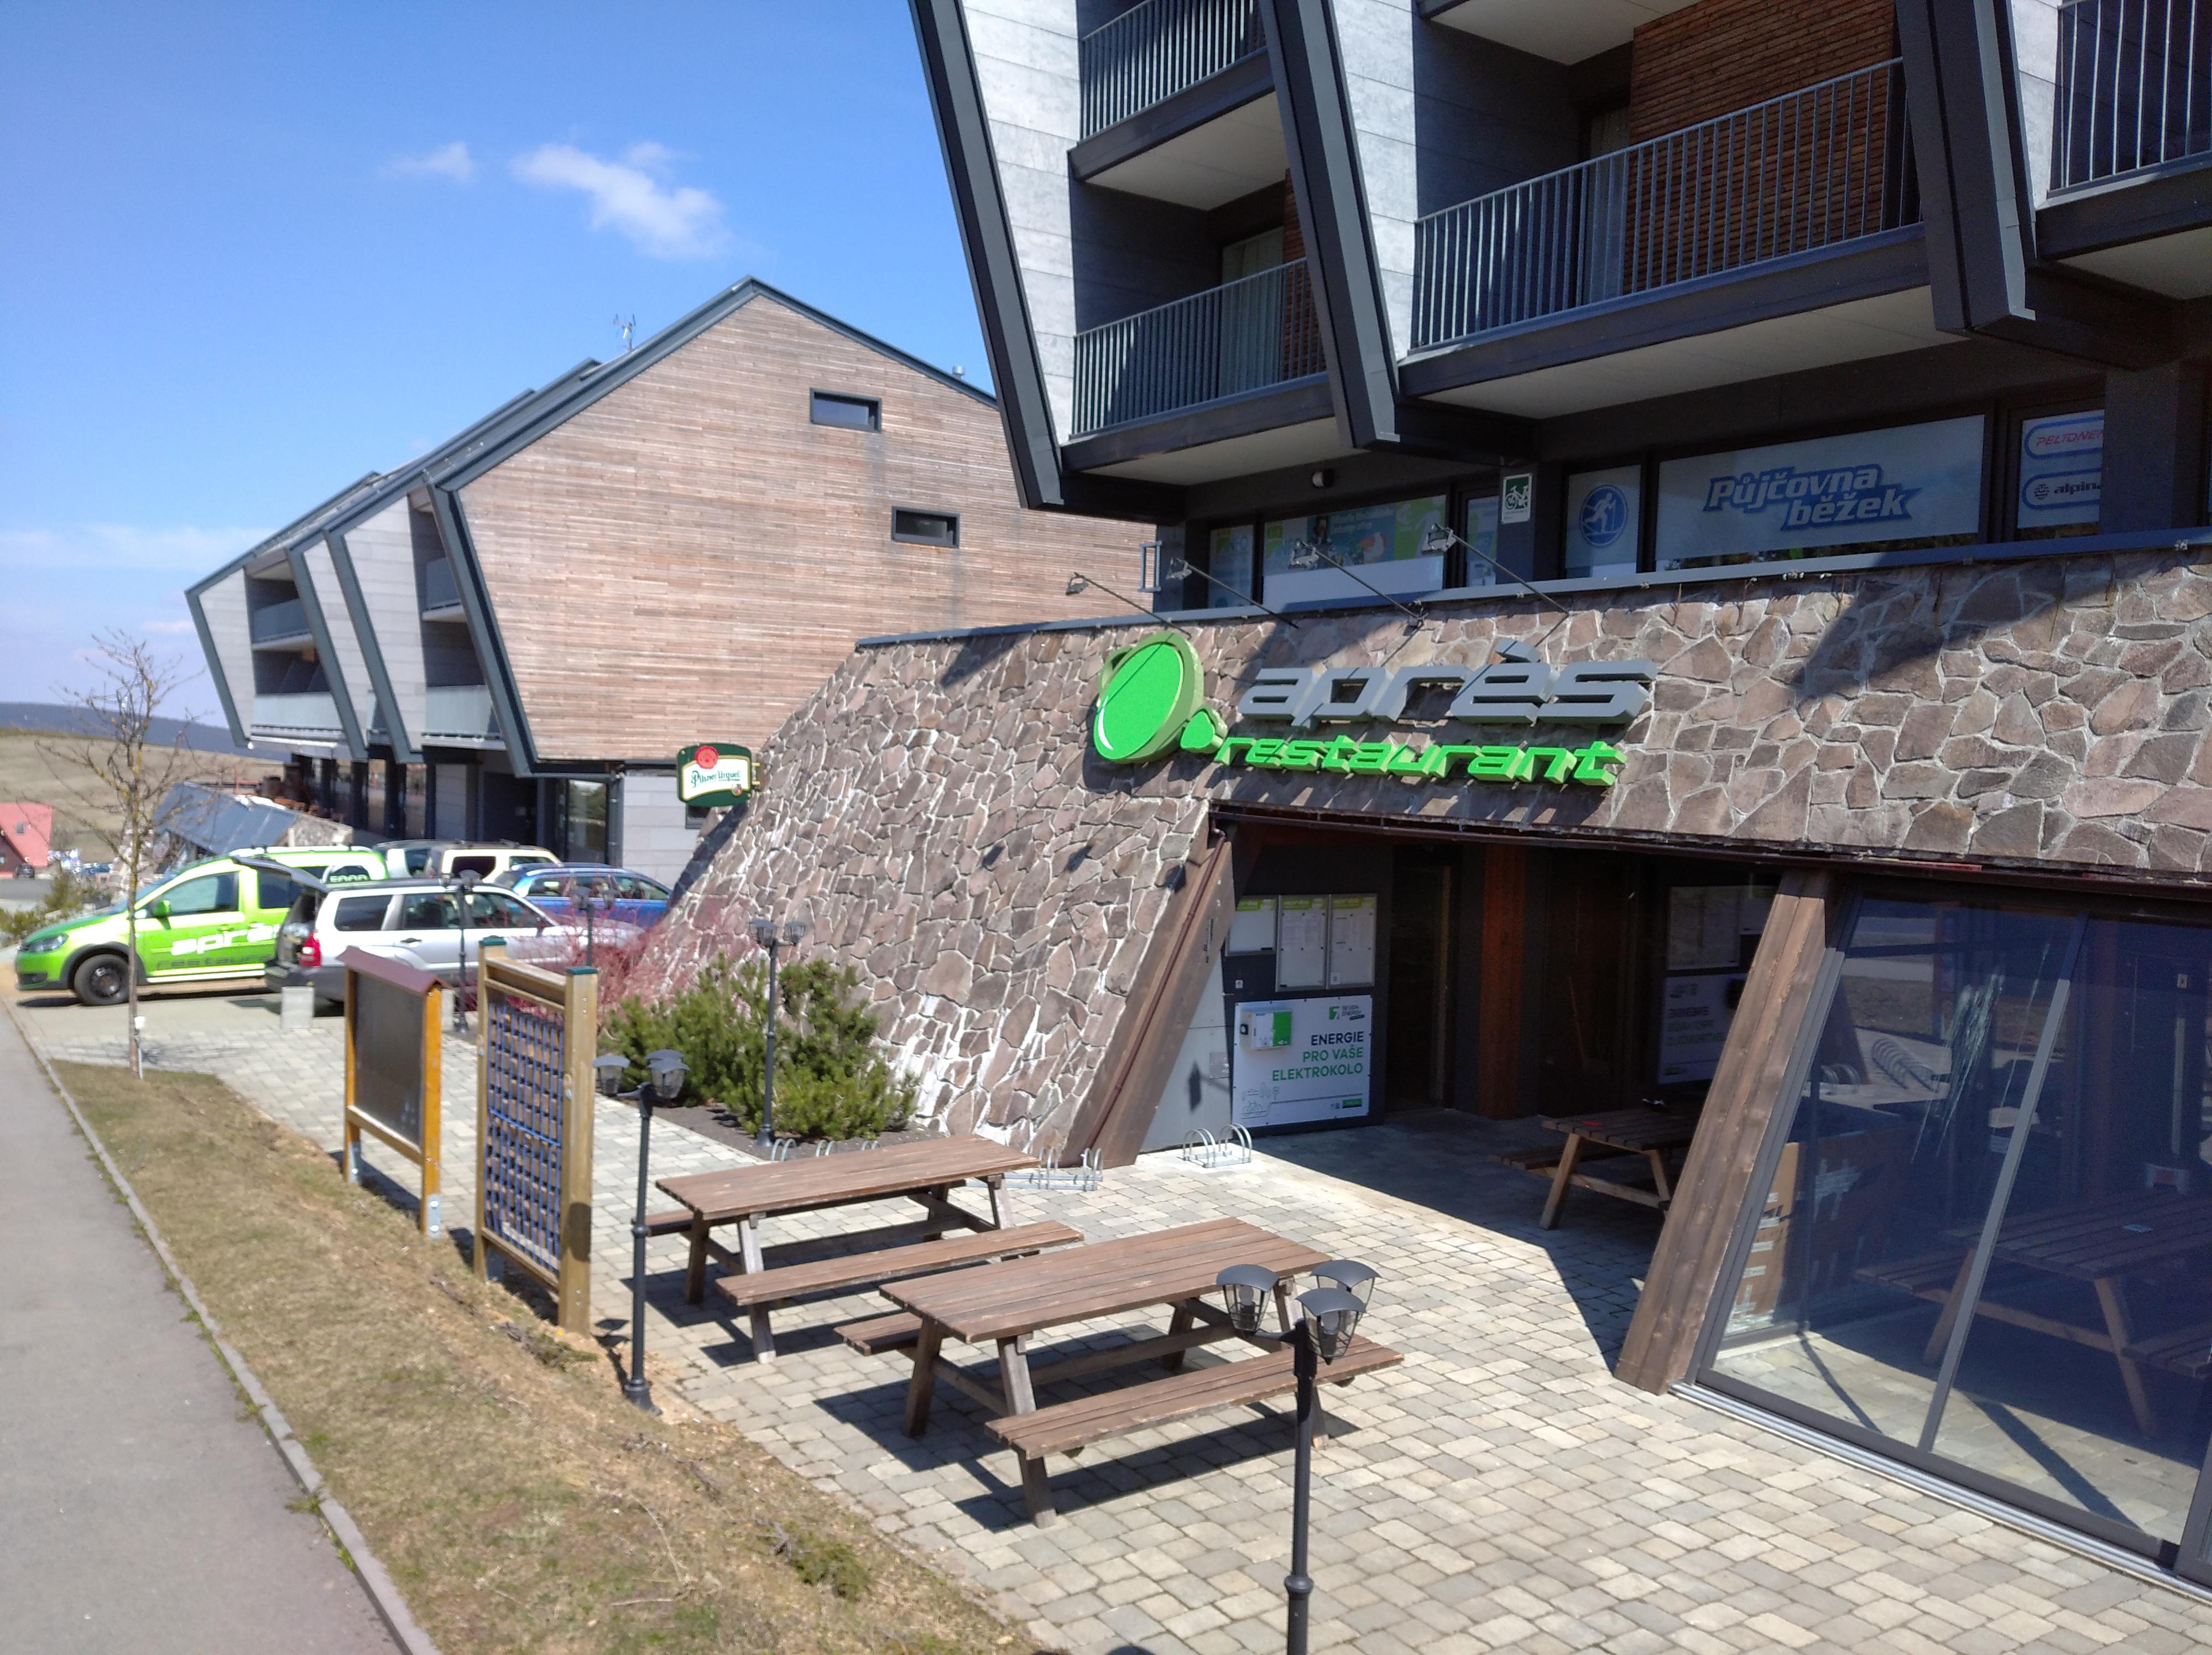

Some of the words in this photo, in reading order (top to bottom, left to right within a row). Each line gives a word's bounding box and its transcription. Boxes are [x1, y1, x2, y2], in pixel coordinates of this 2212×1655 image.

[1707, 467, 1879, 509] Půjčovna
[1787, 489, 1906, 526] běžek
[1238, 638, 1658, 729] après
[1215, 735, 1627, 786] restaurant
[691, 770, 717, 788] Pilsner
[718, 770, 740, 782] Urquell
[1311, 1031, 1364, 1046] ENERGIE
[1303, 1050, 1328, 1063] PRO
[1332, 1044, 1364, 1060] VAŠE
[1272, 1063, 1363, 1081] ELEKTROKOLO
